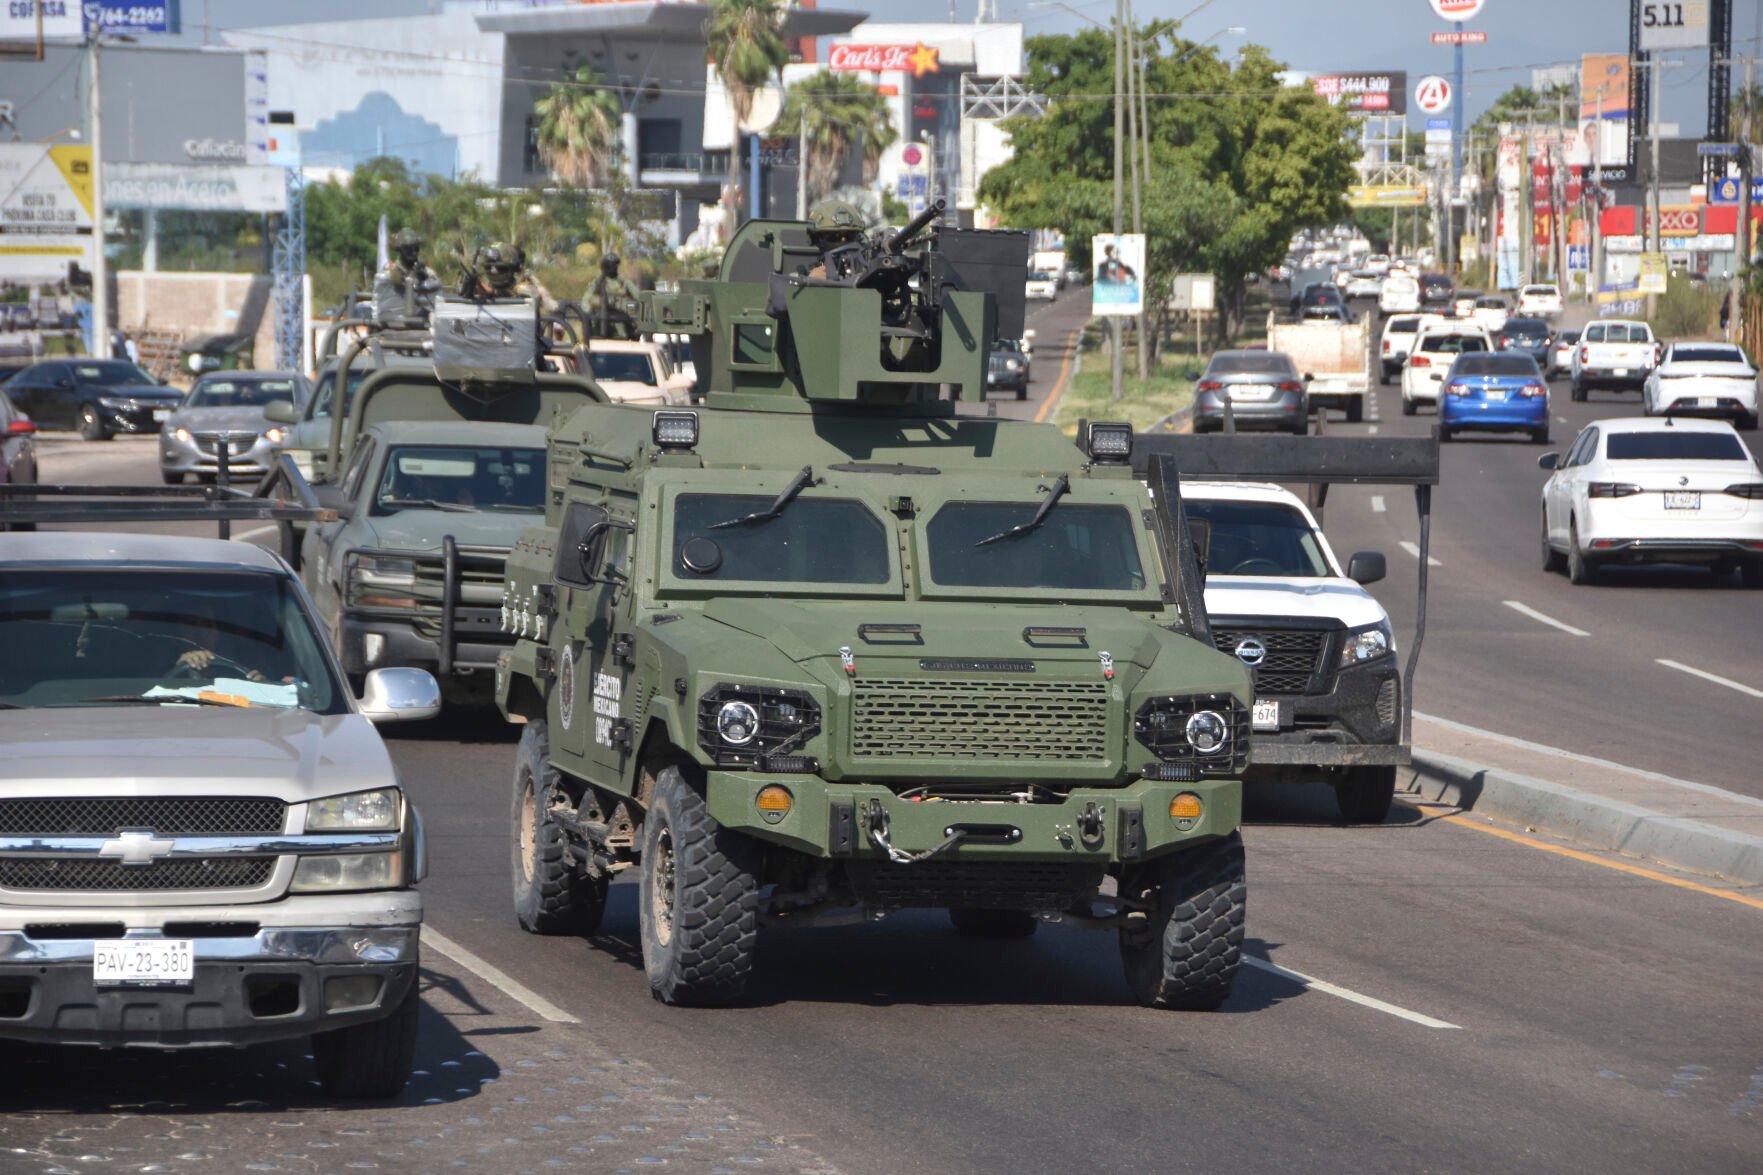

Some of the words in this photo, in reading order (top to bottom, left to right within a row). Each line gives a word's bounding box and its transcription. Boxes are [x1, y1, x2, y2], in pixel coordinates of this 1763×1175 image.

[1643, 4, 1684, 27] 5.11
[1435, 33, 1459, 43] AUTO
[1461, 33, 1485, 43] KING
[830, 46, 881, 68] Carl's
[97, 952, 188, 973] PAV-23-380
